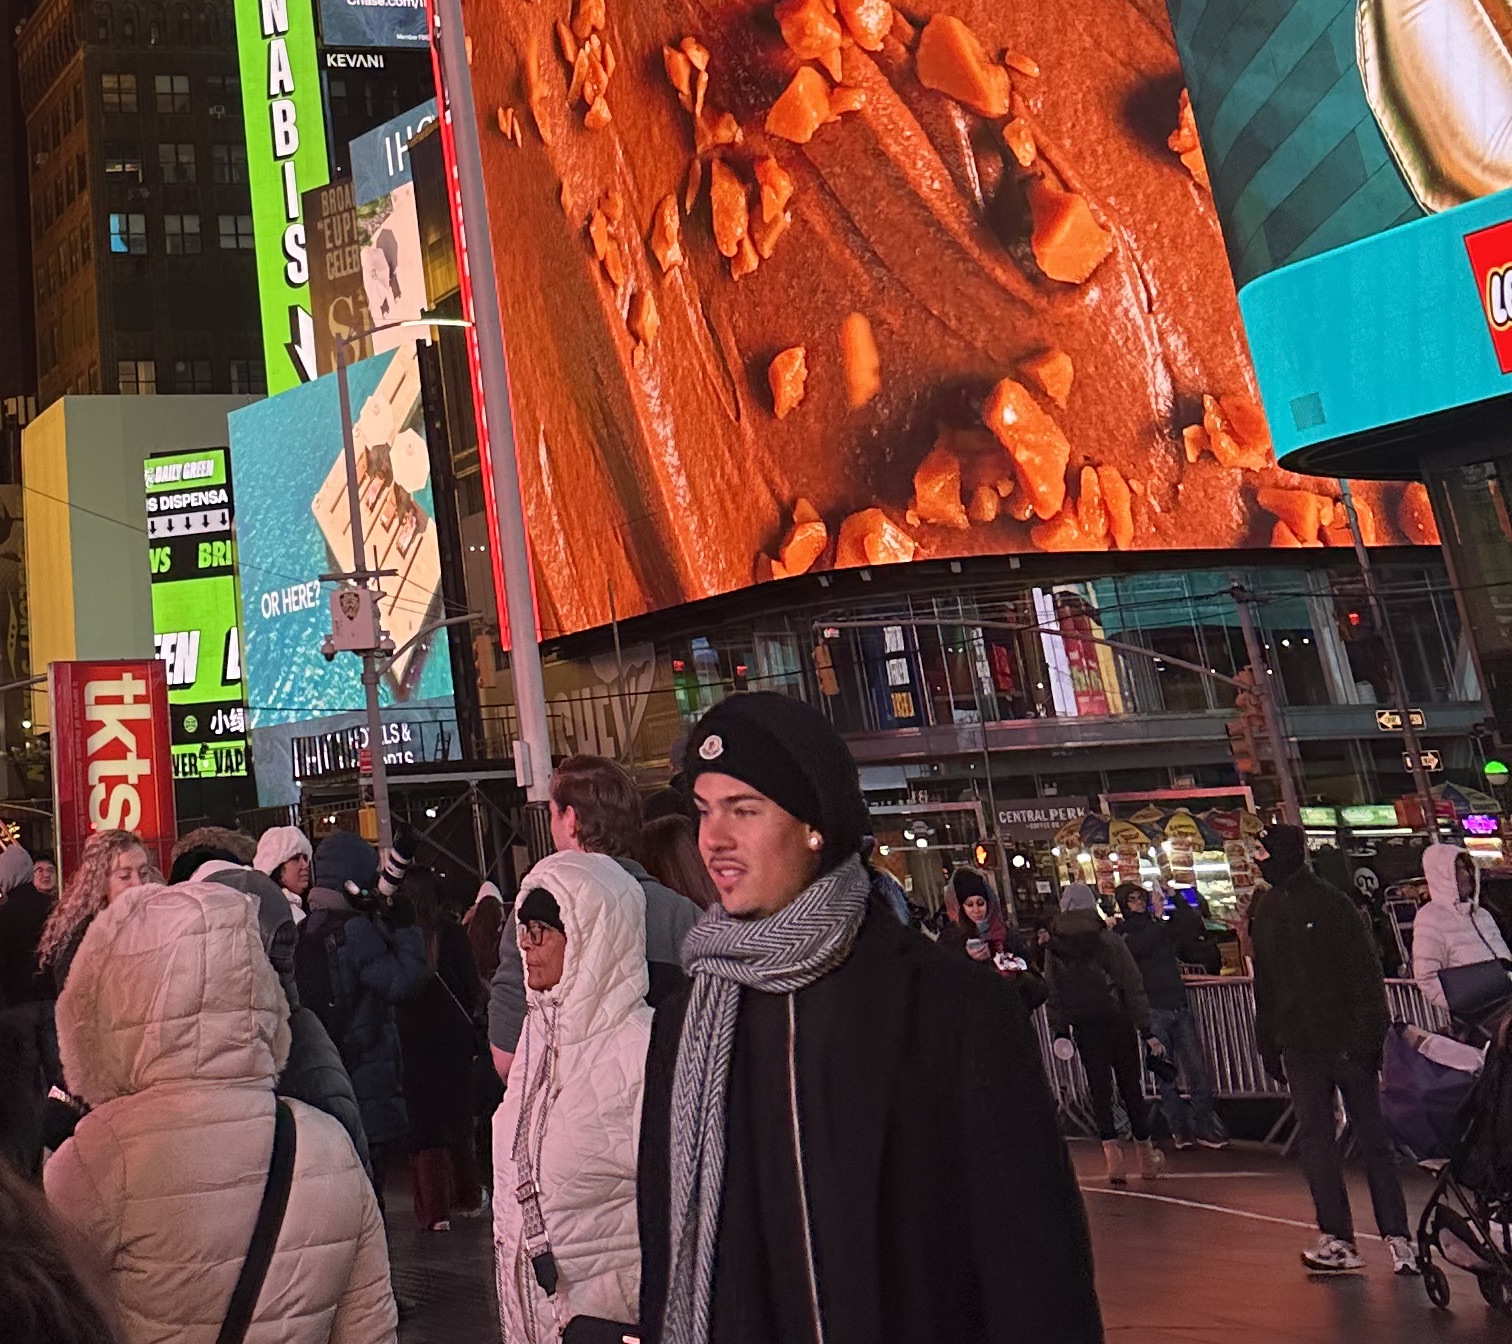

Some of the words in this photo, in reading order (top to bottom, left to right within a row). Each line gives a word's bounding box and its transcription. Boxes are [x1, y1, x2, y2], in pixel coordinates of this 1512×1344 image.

[326, 53, 385, 69] KEVANI
[155, 463, 183, 483] DAILY
[182, 459, 215, 480] GREEN
[159, 489, 229, 511] DISPENSA
[261, 591, 281, 619] OR
[281, 579, 321, 614] HERE?
[83, 672, 152, 832] tkts
[998, 809, 1048, 824] CENTRAL
[1048, 807, 1087, 822] PERK
